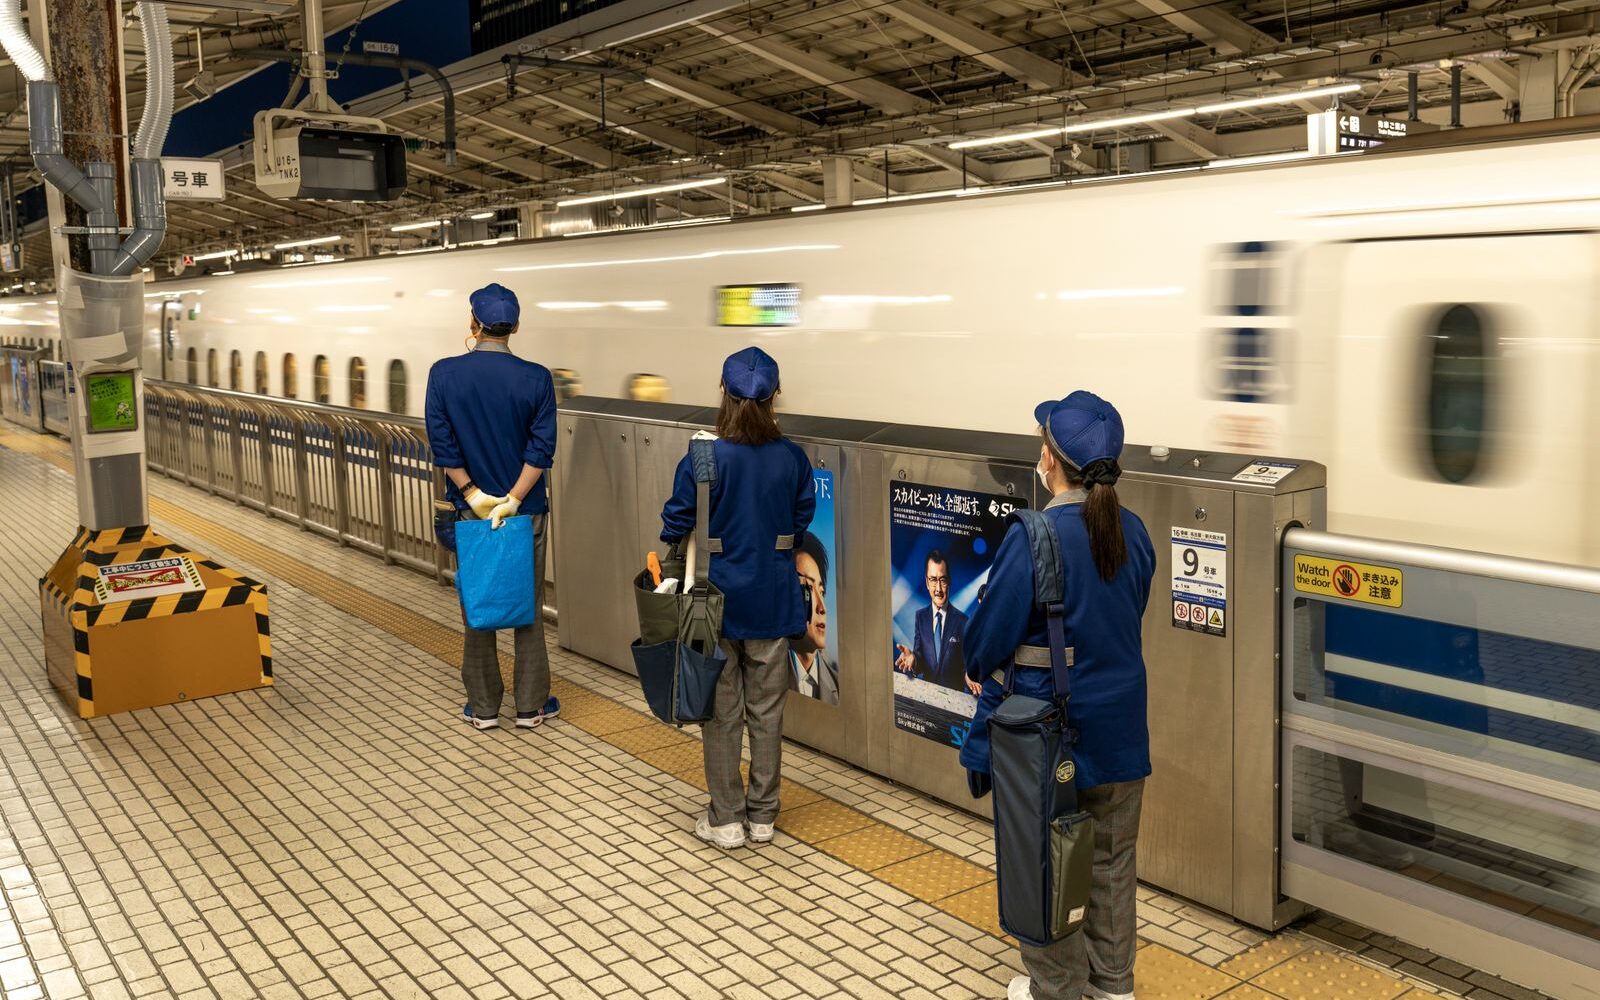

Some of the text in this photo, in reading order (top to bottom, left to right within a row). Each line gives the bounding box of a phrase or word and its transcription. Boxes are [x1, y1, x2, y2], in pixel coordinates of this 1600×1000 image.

[276, 155, 296, 166] U16-
[171, 171, 209, 188] 号車
[279, 168, 299, 179] TNK2
[893, 486, 981, 516] スカイピースは、全部返す。
[1000, 502, 1020, 517] Sk
[1297, 562, 1330, 577] Watch
[1296, 575, 1331, 588] the door
[1362, 572, 1399, 587] まき込み
[1369, 585, 1392, 600] 注意
